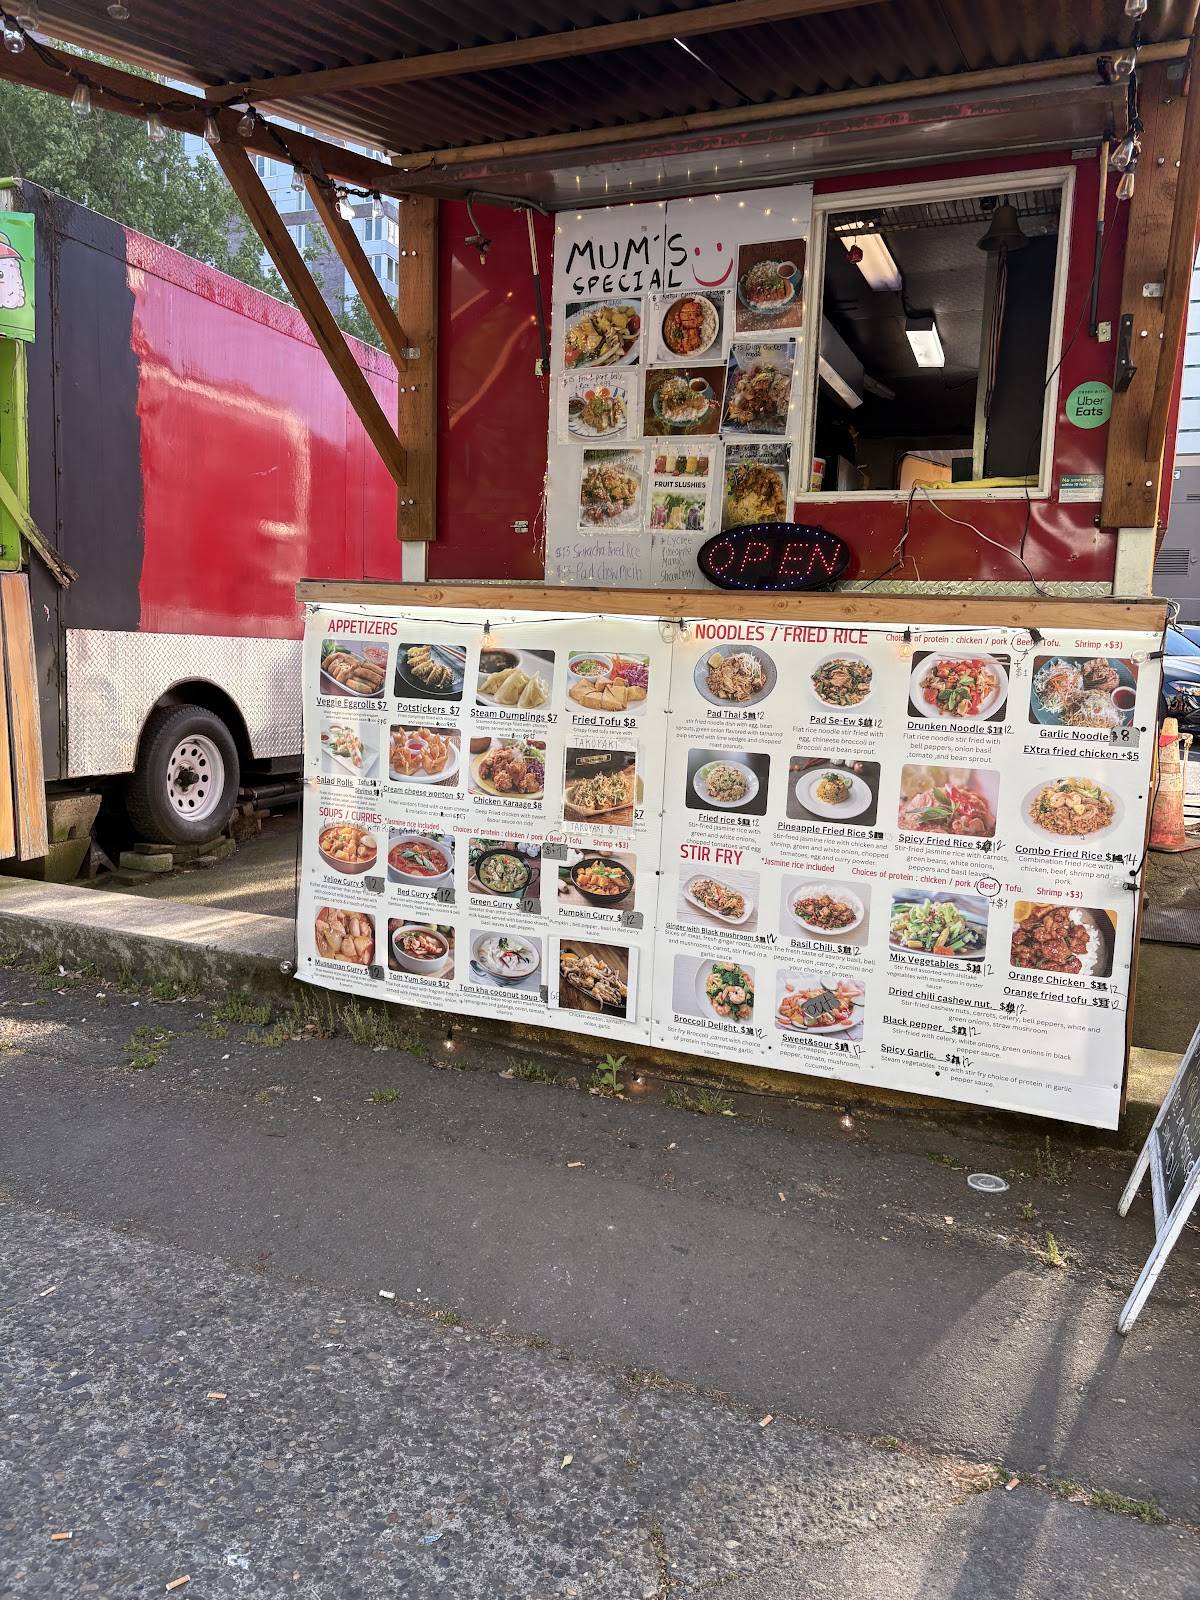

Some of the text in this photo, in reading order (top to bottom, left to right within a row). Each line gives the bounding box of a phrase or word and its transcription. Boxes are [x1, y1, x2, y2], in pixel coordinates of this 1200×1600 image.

[573, 269, 683, 295] SPECIAL
[1077, 397, 1104, 405] Uber
[1076, 407, 1103, 416] Eats
[709, 542, 840, 575] OPEN
[328, 620, 398, 635] APPETIZERS
[695, 624, 868, 644] NOODLES FRIED RICE
[924, 636, 948, 644] protein
[956, 637, 983, 645] chicken
[992, 638, 1007, 646] pork
[1075, 640, 1101, 649] Shrimp
[317, 697, 387, 709] Veggie Eggrolls $7
[397, 703, 460, 716] Potstickers $7
[471, 709, 558, 723] Steam Dumplings $7
[572, 715, 636, 727] Fried Tofu $8
[707, 710, 741, 719] Pad Thai
[810, 716, 856, 725] Pad Se-Ew
[907, 722, 985, 733] Drunken Noodle
[1040, 729, 1108, 741] Garlic Noodle
[573, 738, 619, 748] TAKOYAKI
[976, 746, 992, 754] basil
[1052, 747, 1077, 757] fried
[1079, 749, 1118, 759] chicken
[1121, 750, 1139, 761] +$5
[317, 776, 354, 787] Salad Rolls
[384, 785, 465, 801] Cream cheese wonton $7
[473, 796, 501, 806] Chicken
[503, 799, 532, 810] Karaage
[319, 807, 342, 819] SOUPS
[351, 812, 382, 824] CURRIES
[417, 822, 440, 830] included
[698, 814, 719, 824] Fried
[778, 822, 866, 838] Pineapple Fried Rice
[481, 829, 500, 837] protein
[549, 834, 563, 843] Beef
[592, 839, 613, 848] Shrimp
[899, 834, 973, 848] Spicy Fried Rice
[680, 844, 711, 862] STIR
[715, 848, 743, 866] FRY
[791, 860, 805, 870] rice
[806, 862, 835, 873] included
[1016, 845, 1103, 860] Combo Fried Rice
[1019, 856, 1062, 865] Combination
[323, 875, 360, 887] Yellow Curry
[852, 868, 877, 877] Choices
[889, 873, 914, 881] protein
[920, 875, 946, 884] chicken
[955, 879, 971, 888] pork
[979, 881, 997, 890] Beef
[1005, 883, 1023, 893] Tofu.
[1037, 888, 1062, 897] Shrimp
[397, 887, 429, 899] Red Curry
[470, 898, 513, 910] Green Curry
[558, 907, 591, 920] Pumpkin
[592, 911, 614, 922] Curry
[665, 922, 754, 941] Ginger with Black mushroom
[791, 939, 811, 948] Basil
[314, 959, 363, 975] Mussaman Curry
[889, 953, 959, 969] Mix Vegetables
[389, 972, 450, 988] Tom Yum Soup $12
[1008, 971, 1085, 988] Orange Chicken
[459, 984, 538, 1002] Tom kha coconut soup
[889, 987, 913, 997] Dried
[915, 991, 935, 1000] chili
[937, 995, 972, 1006] cashew
[1003, 986, 1087, 1005] Orange fried tofu
[674, 1014, 706, 1027] Broccoli
[883, 1015, 908, 1025] Black
[782, 1034, 832, 1049] Sweet&sour
[881, 1044, 905, 1055] Spicy
